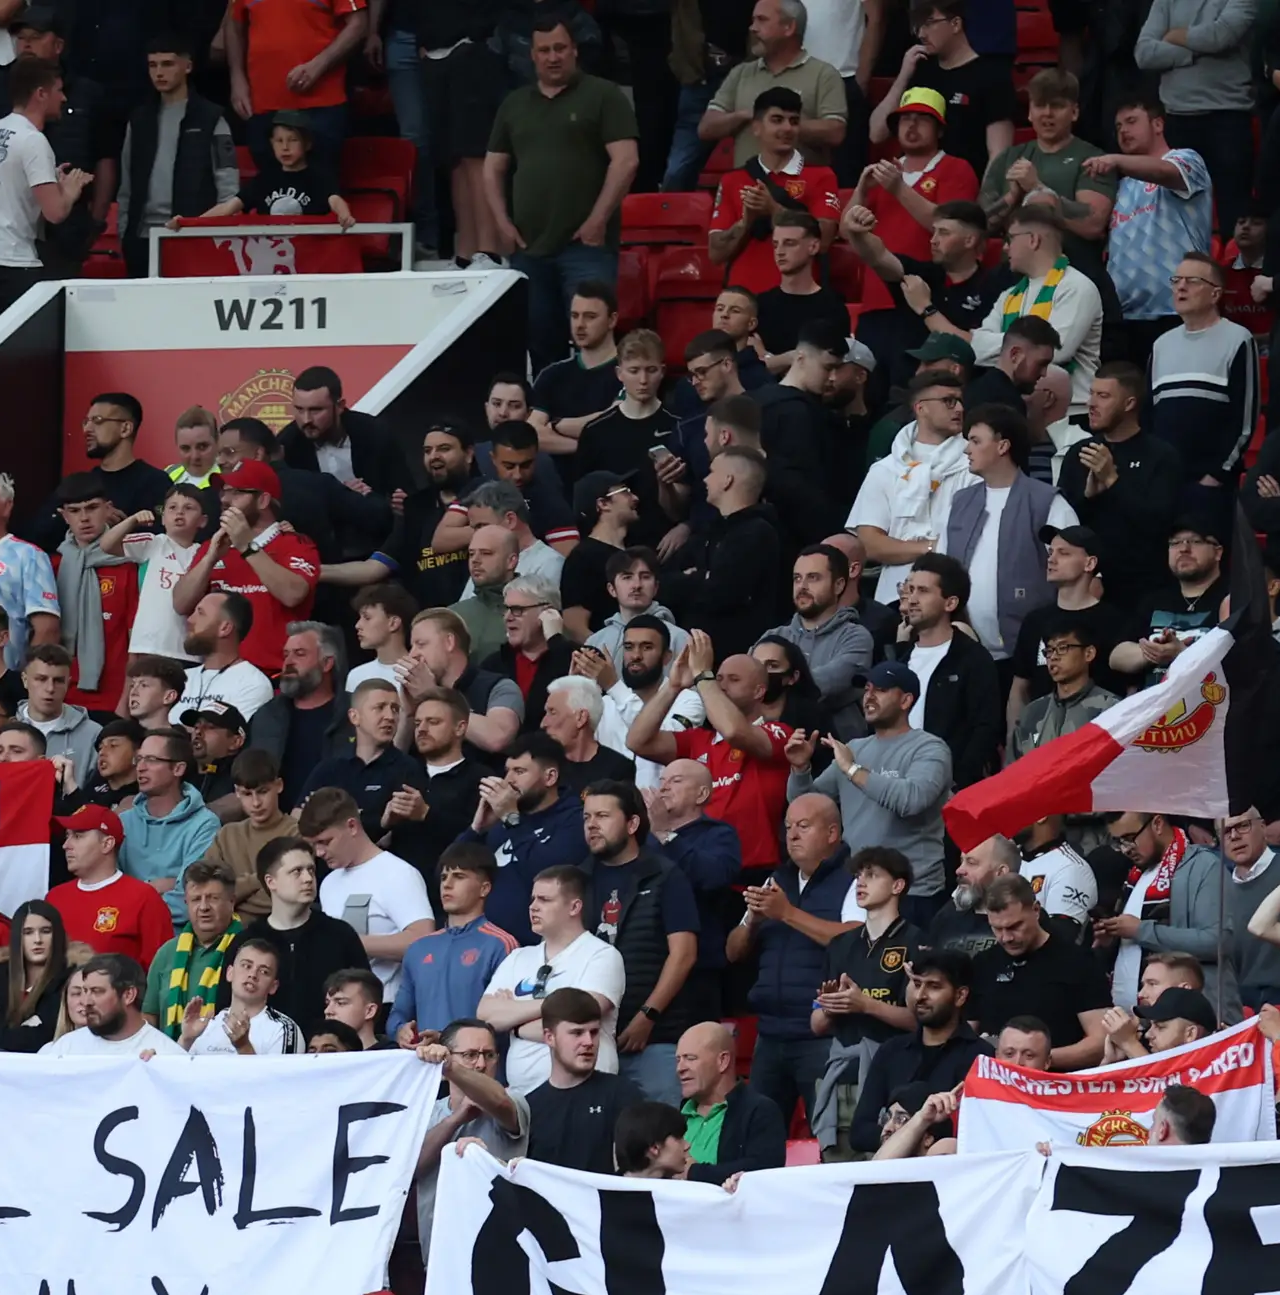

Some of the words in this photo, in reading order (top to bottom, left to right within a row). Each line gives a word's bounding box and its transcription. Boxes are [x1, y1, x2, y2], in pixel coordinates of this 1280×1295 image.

[296, 191, 312, 207] IS
[214, 298, 327, 331] W211
[231, 378, 294, 420] MANCHE
[861, 987, 891, 998] ARP
[81, 1101, 407, 1234] SALE
